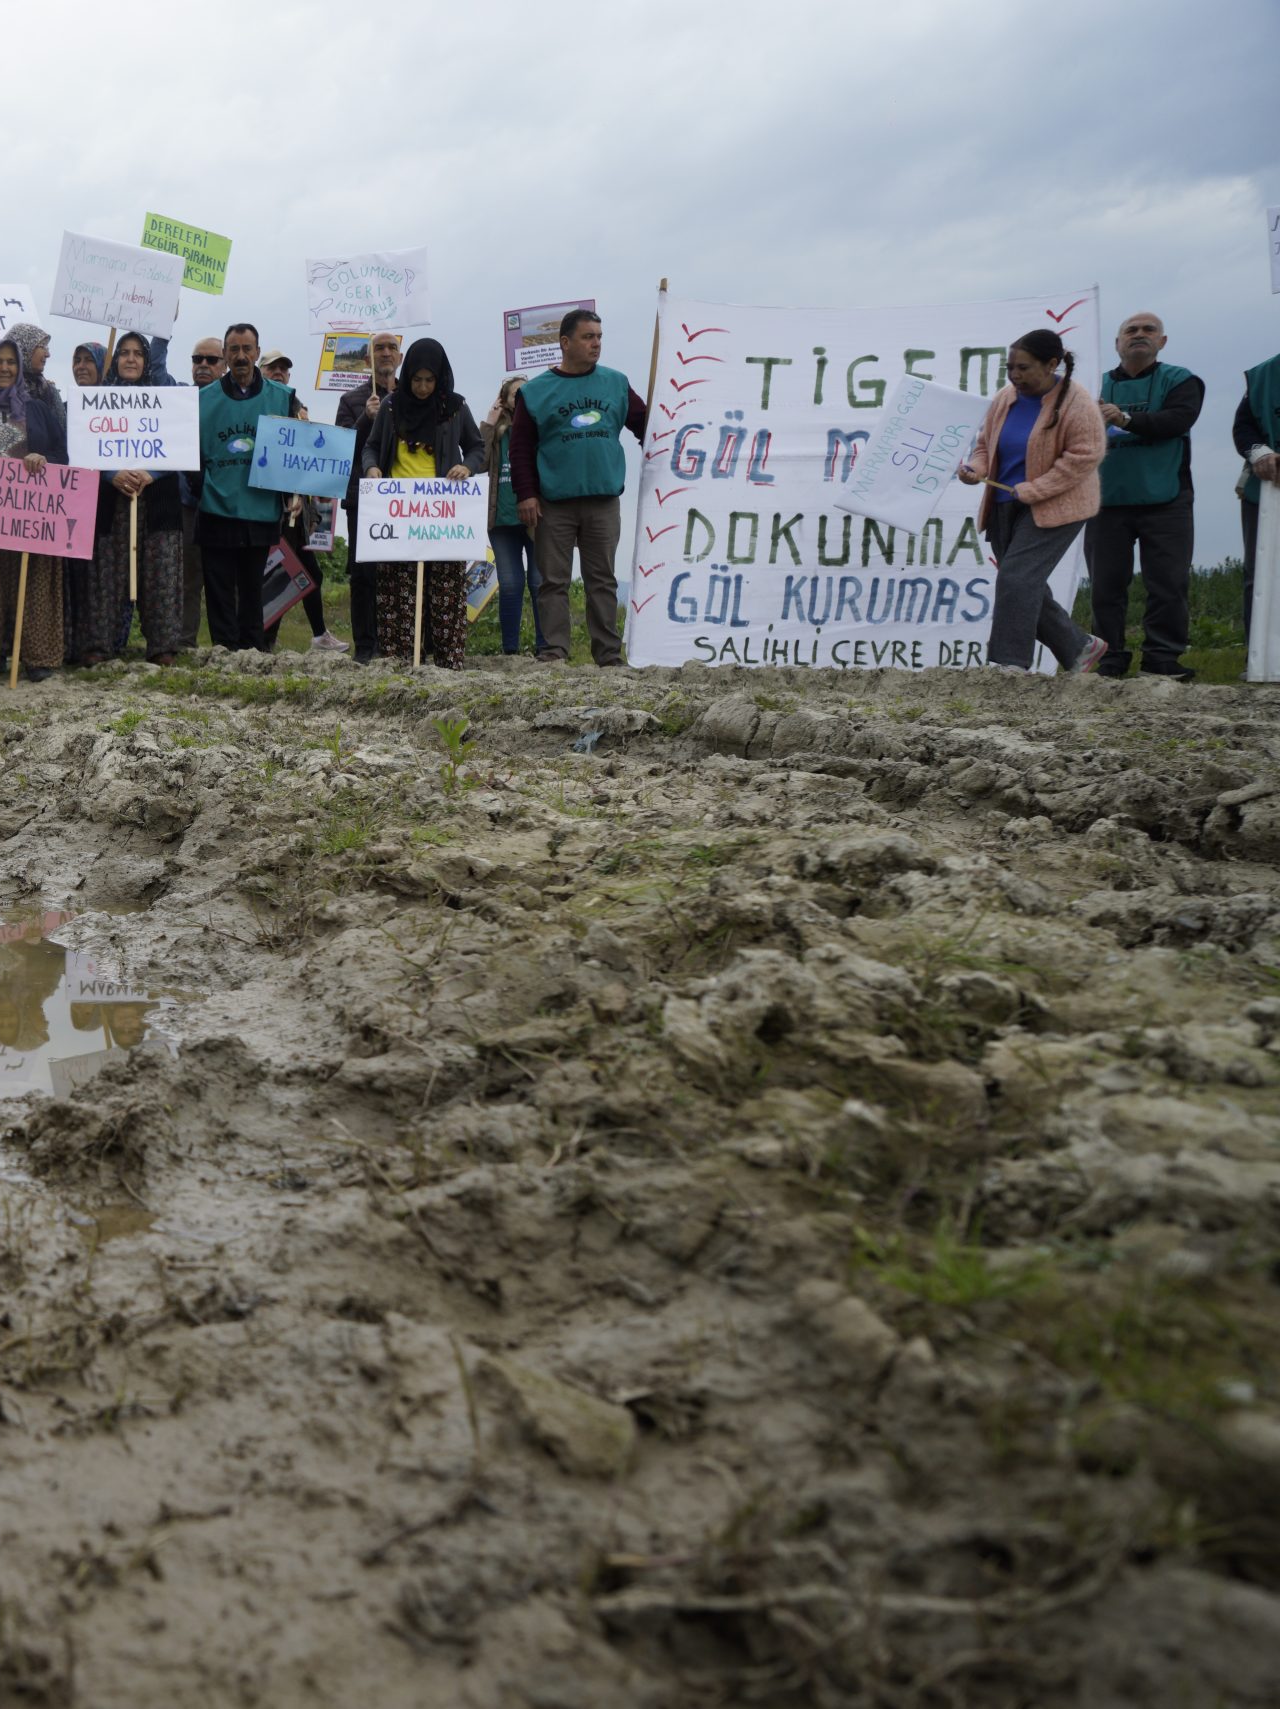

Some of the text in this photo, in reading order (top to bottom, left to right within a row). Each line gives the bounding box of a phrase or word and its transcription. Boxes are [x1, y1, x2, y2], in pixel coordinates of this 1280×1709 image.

[82, 392, 162, 410] MARMARA
[138, 417, 159, 433] SU
[278, 427, 296, 447] SU
[671, 409, 775, 487] GÖL
[59, 469, 80, 490] VE
[414, 480, 482, 496] MARMARA
[389, 499, 456, 518] OLMASIN
[408, 524, 475, 540] MARMARA
[683, 508, 985, 568] DOKUNMA
[667, 563, 989, 627] GÖL KURUMAS
[831, 639, 923, 668] ÇEVRE
